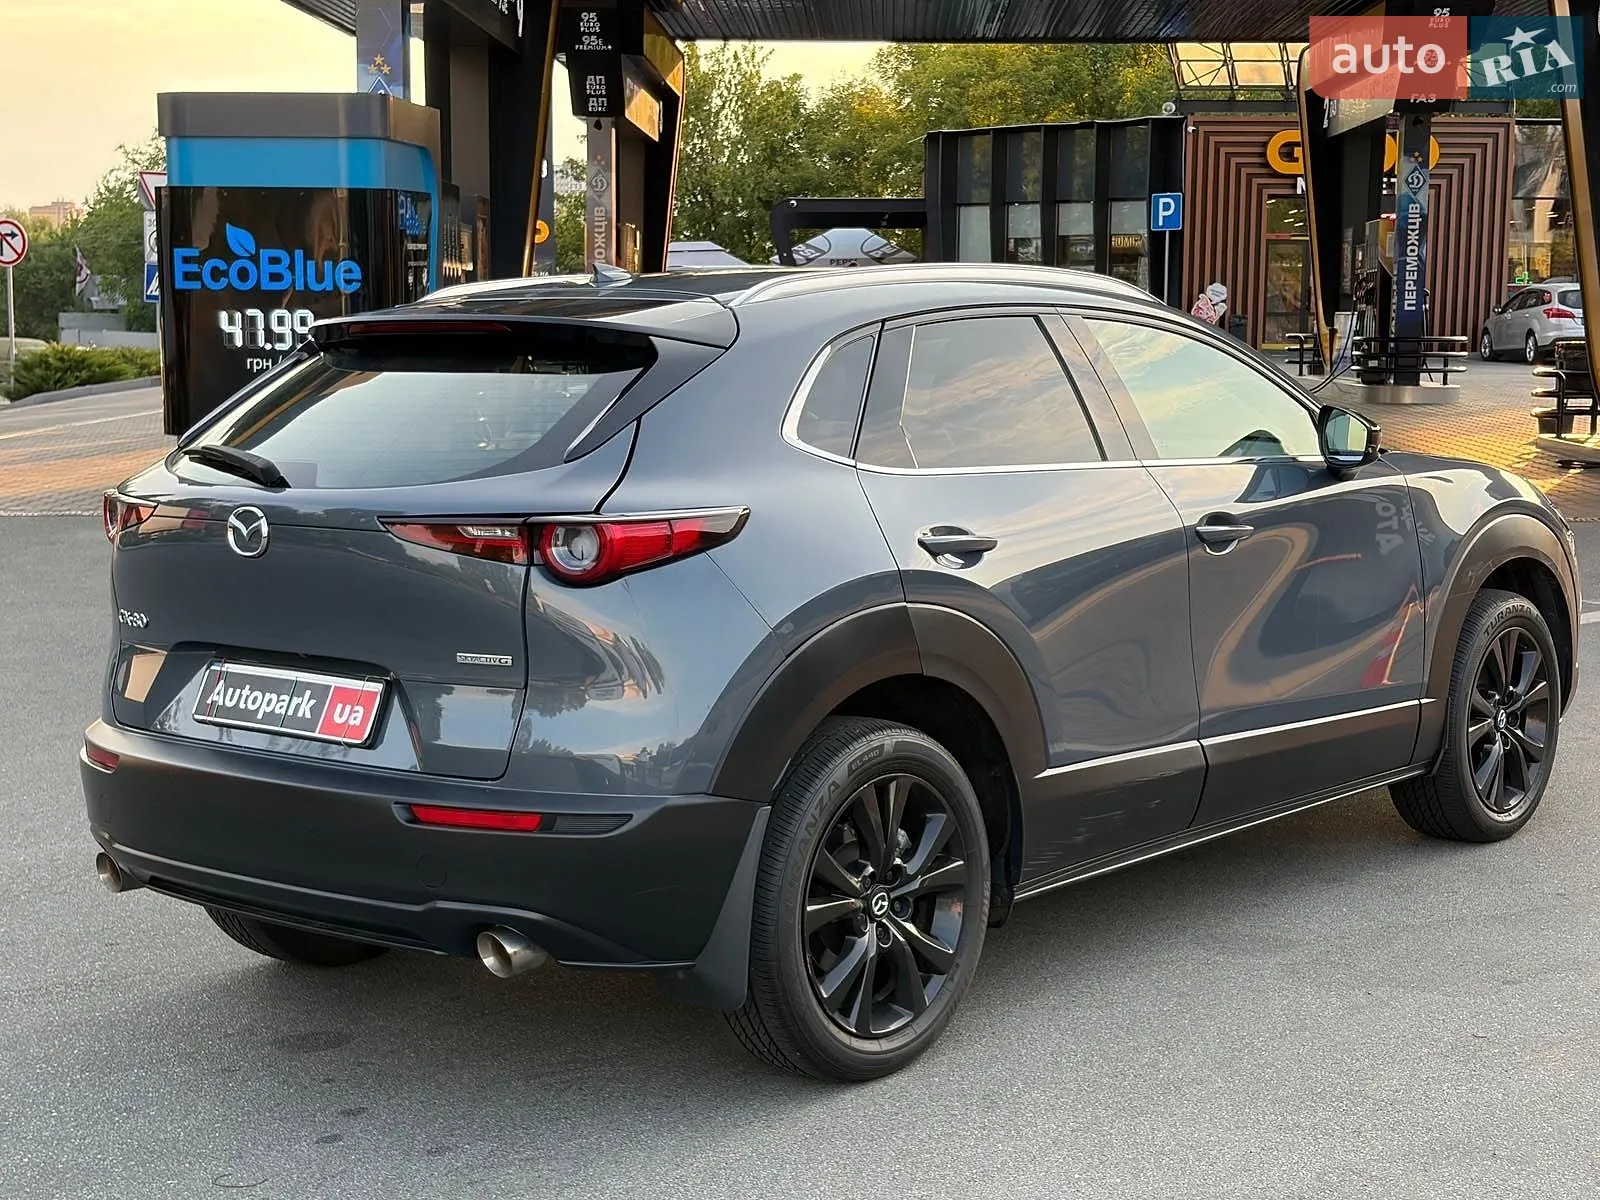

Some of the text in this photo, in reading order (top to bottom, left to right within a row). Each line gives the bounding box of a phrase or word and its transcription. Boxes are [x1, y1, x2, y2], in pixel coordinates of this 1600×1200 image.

[581, 12, 598, 22] 95
[1410, 93, 1437, 103] ГАЗ
[1157, 197, 1175, 226] P
[173, 248, 363, 293] EcoBlue
[1403, 203, 1423, 311] ПЕРЕМОЖЦІВ
[219, 309, 315, 351] 47.99
[246, 357, 273, 373] грн
[1483, 604, 1532, 637] TURANZA
[206, 679, 365, 726] Autopark ua
